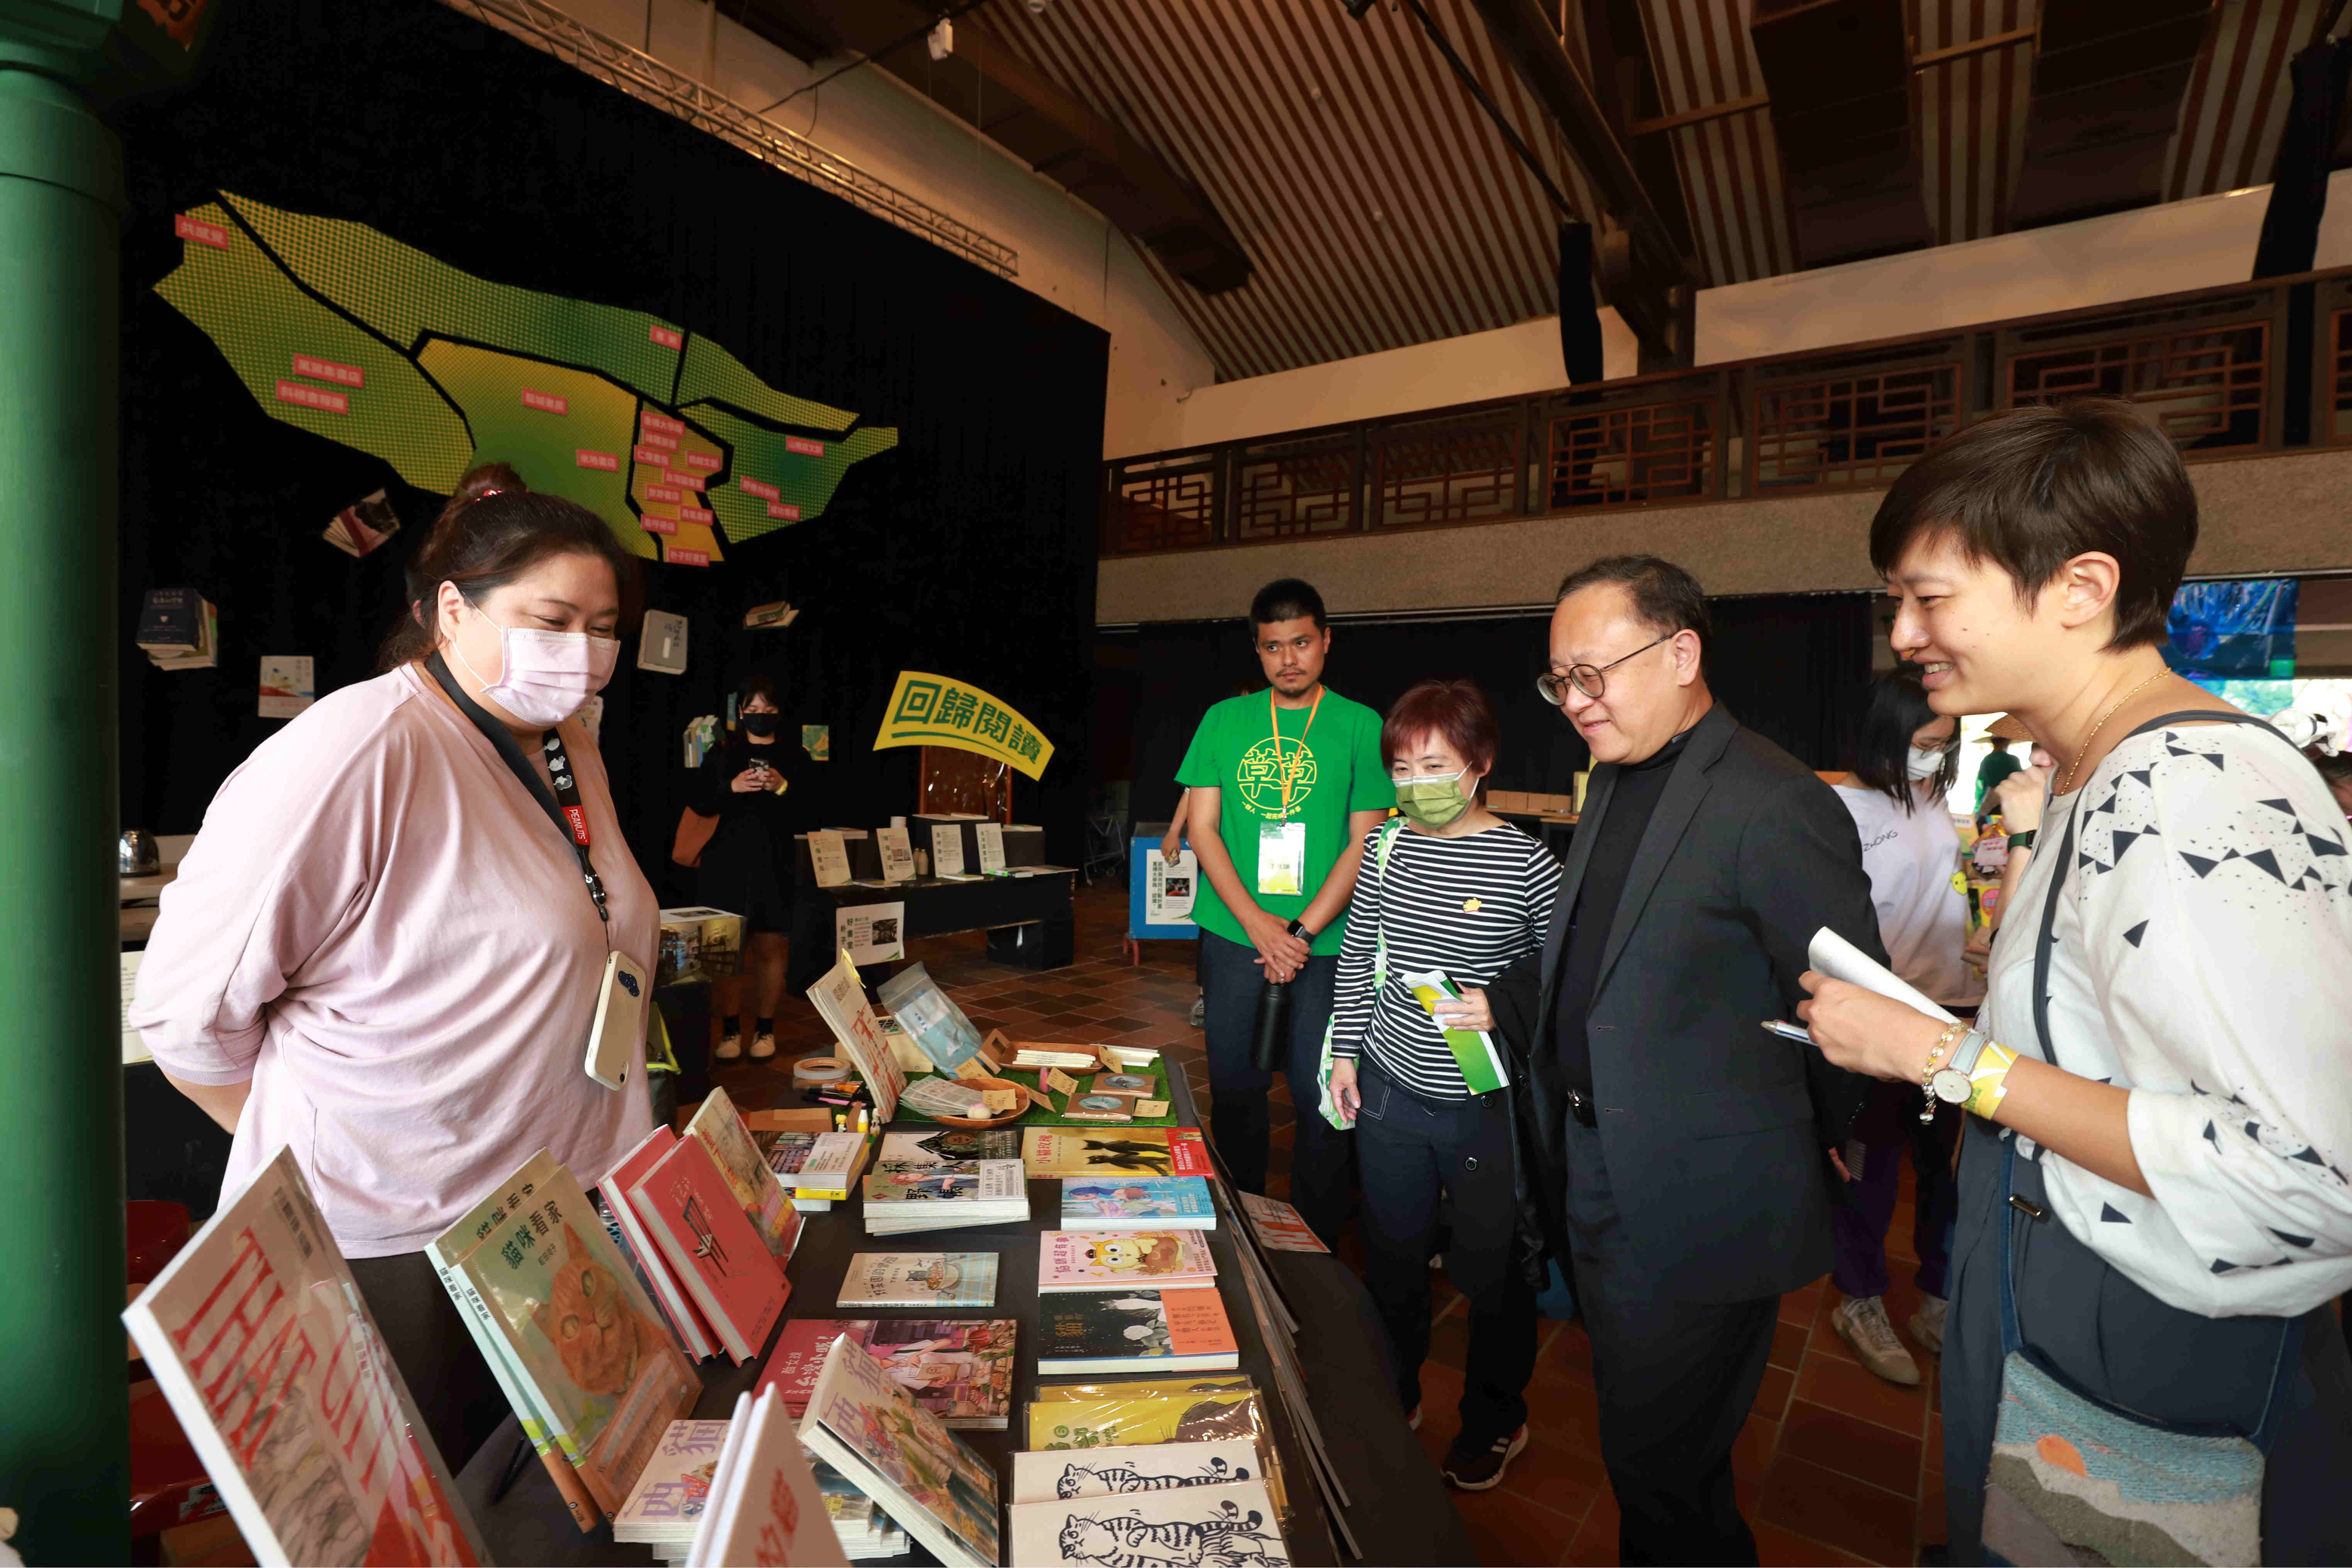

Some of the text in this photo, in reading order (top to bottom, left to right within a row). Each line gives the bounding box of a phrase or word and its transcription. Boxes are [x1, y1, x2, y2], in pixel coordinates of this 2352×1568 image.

[892, 680, 1043, 764] 回歸閱讀
[569, 809, 586, 840] PEANUTS
[881, 1161, 964, 1174] 採集人
[1035, 1135, 1053, 1165] 小貓玫瑰
[905, 1186, 964, 1200] 野帳
[501, 1200, 563, 1270] 貓咪看家
[1053, 1237, 1071, 1273] 貓咪超有事
[439, 1267, 465, 1301] 貓咪看家
[466, 1288, 491, 1321] 貓咪看家
[172, 1225, 317, 1471] THAT
[842, 1339, 884, 1395] 貓
[663, 1419, 728, 1456] 貓
